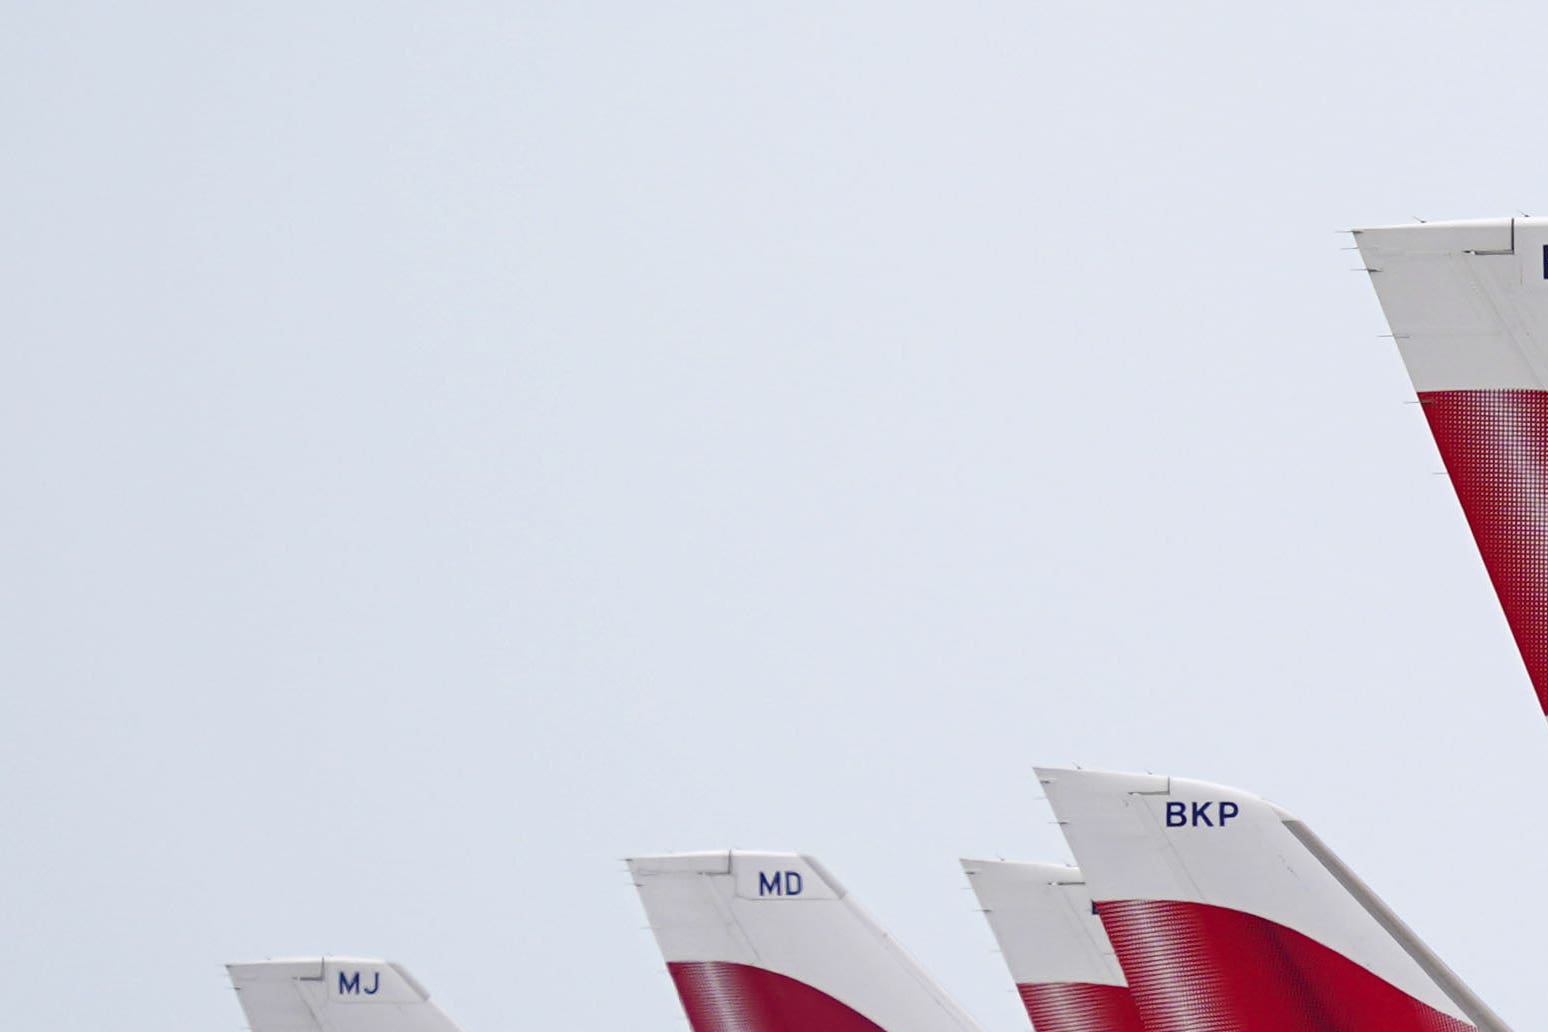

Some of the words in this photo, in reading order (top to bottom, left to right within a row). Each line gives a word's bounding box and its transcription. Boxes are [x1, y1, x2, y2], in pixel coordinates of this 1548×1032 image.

[1167, 802, 1238, 827] BKP
[760, 872, 801, 896] MD
[340, 972, 378, 994] MJ
